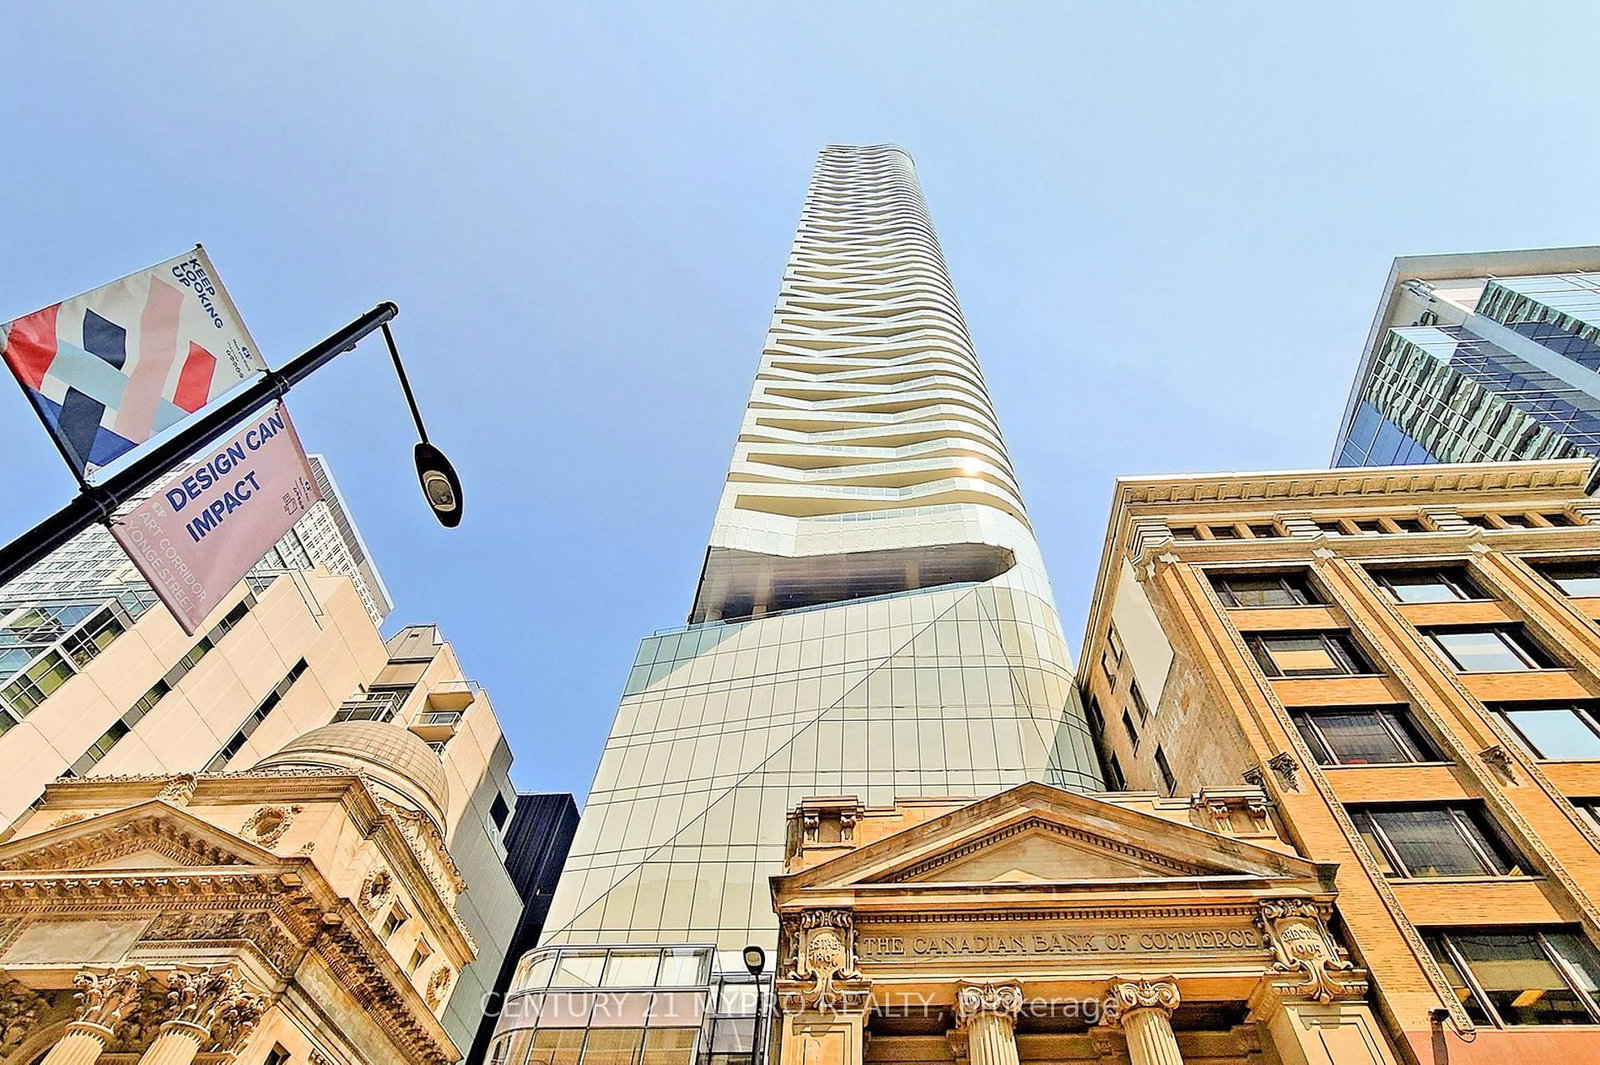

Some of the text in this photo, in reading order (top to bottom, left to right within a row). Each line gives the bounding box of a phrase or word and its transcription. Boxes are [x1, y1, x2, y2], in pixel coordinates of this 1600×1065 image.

[171, 265, 191, 287] UP
[180, 262, 224, 329] LOOKING
[188, 258, 215, 296] KEEP
[165, 441, 247, 512] DESIGN
[245, 412, 285, 451] CAN
[185, 470, 261, 542] IMPACT
[125, 520, 196, 612] YONGE STREET
[139, 511, 207, 600] ART CORRIDOR
[862, 936, 905, 955] THE
[912, 936, 1028, 955] CANADIAN
[1031, 935, 1100, 953] BANK
[1105, 934, 1130, 951] OF
[1139, 930, 1260, 950] COMMERCE
